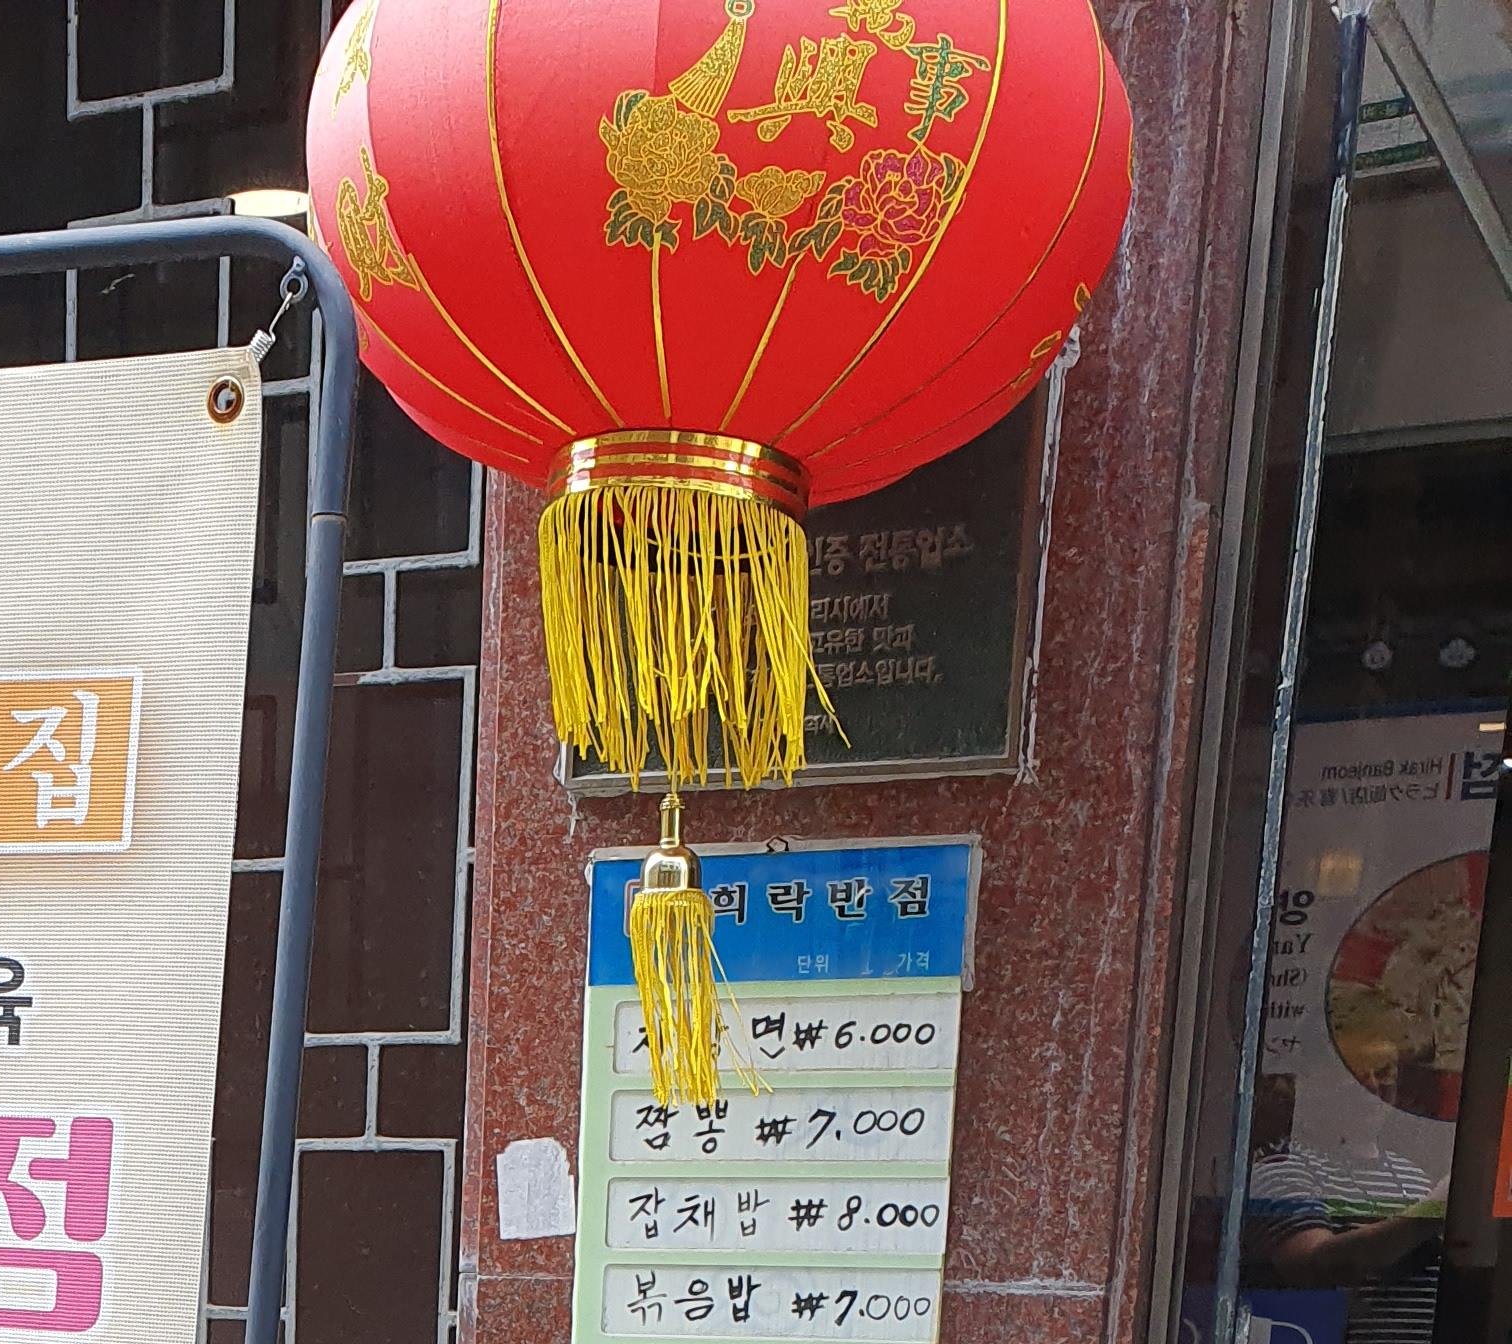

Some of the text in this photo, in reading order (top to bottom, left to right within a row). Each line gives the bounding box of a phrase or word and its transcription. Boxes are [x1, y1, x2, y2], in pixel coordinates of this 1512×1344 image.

[810, 593, 890, 623] 리시에서
[808, 655, 944, 689] 통업소입니다.
[796, 949, 931, 975] 단위 가격
[636, 1100, 729, 1154] 짬뽕
[629, 1186, 771, 1241] 잡채밥
[626, 1270, 762, 1325] 볶음밥
